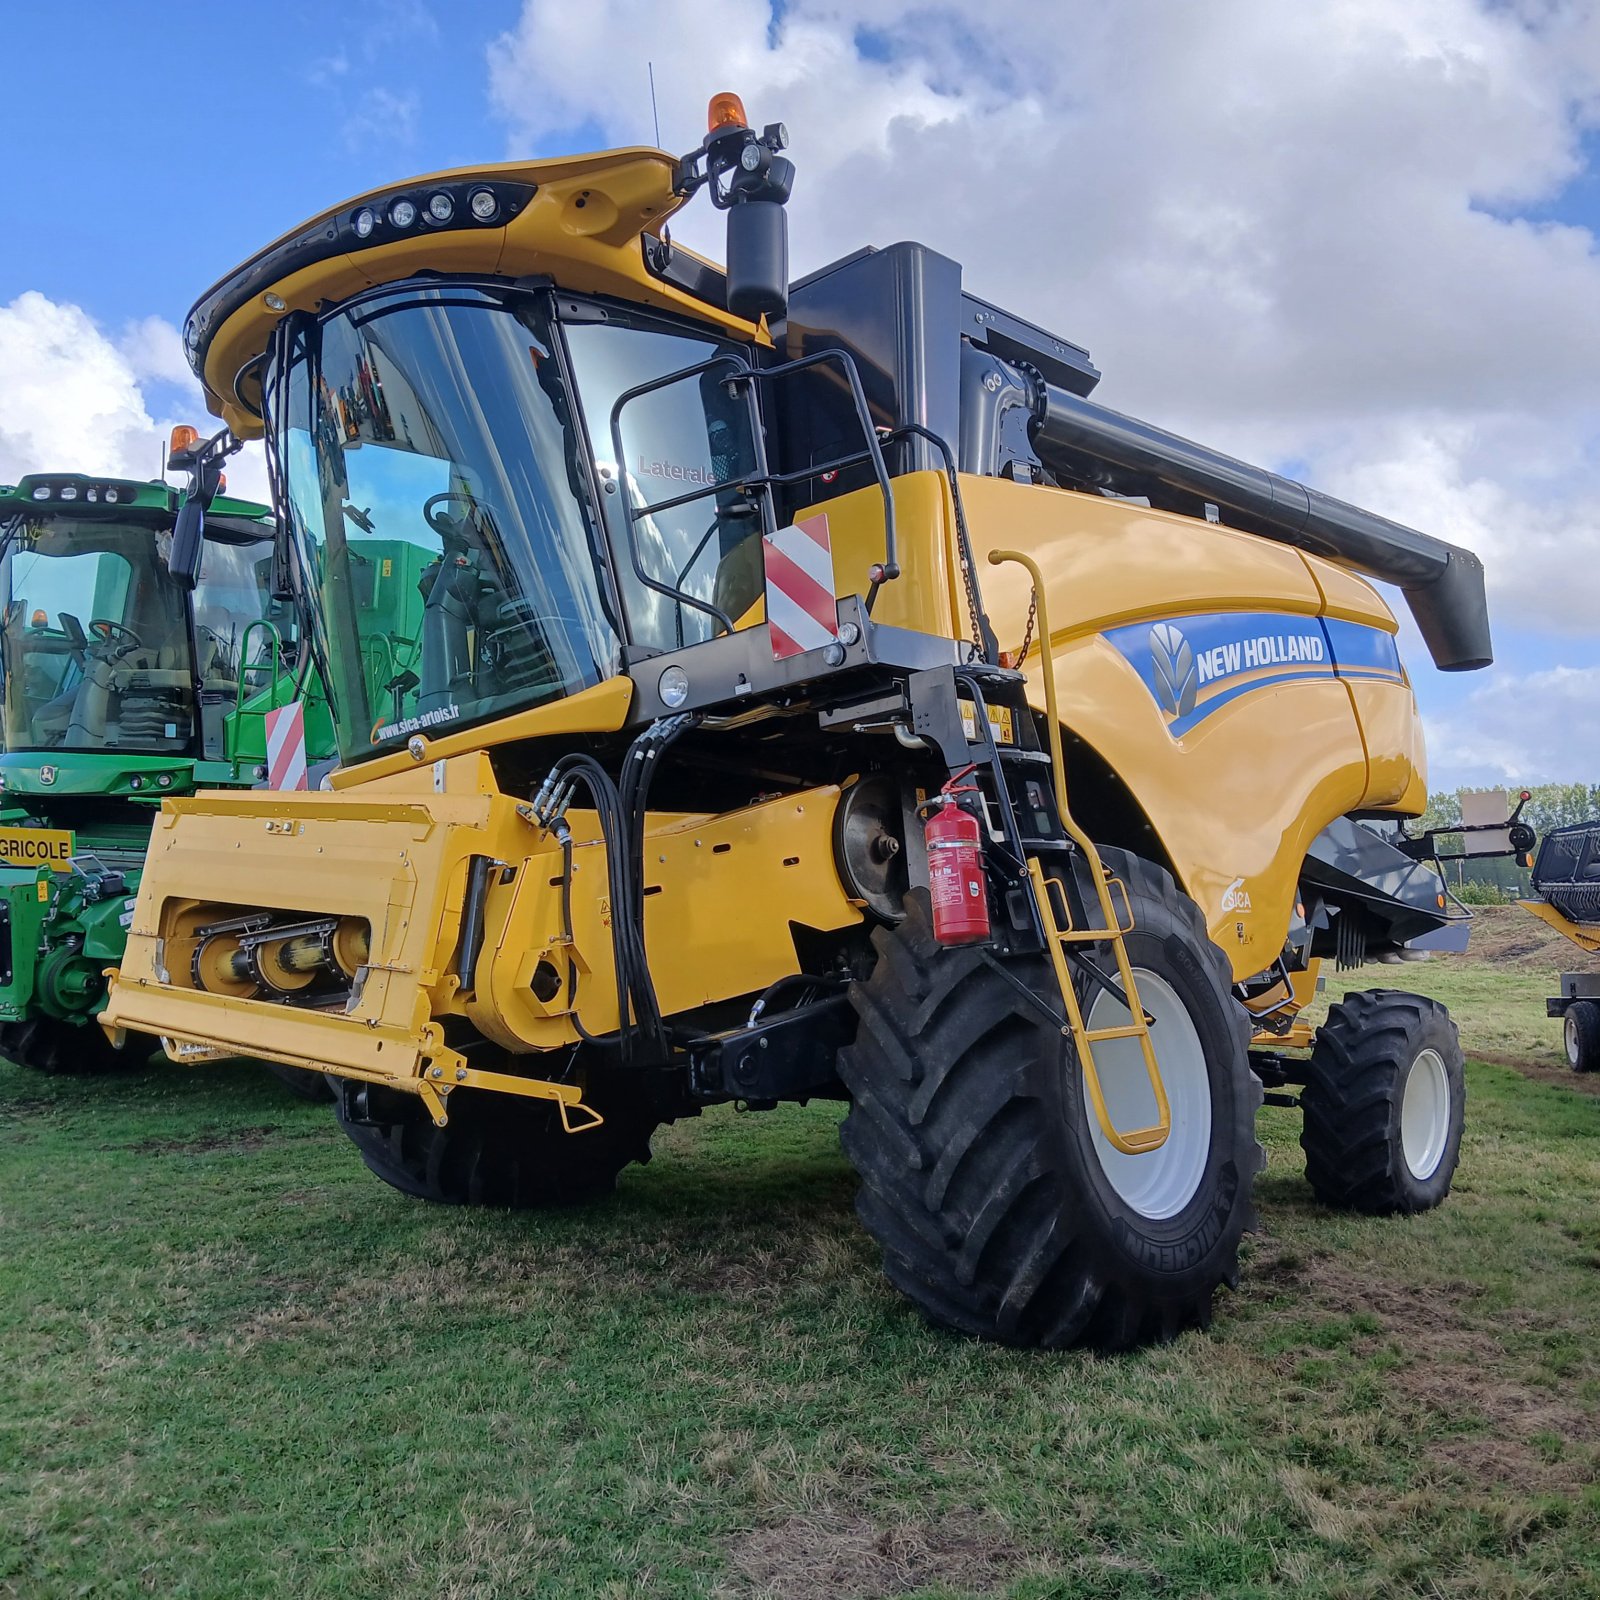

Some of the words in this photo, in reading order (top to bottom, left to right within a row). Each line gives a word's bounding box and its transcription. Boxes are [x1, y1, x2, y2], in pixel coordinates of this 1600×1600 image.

[638, 455, 717, 486] Laterale
[1196, 642, 1241, 683] NEW
[1243, 635, 1324, 668] HOLLAND
[378, 704, 460, 740] www.sica-artois.fr
[1228, 891, 1251, 908] SICA
[1124, 1210, 1223, 1272] MICHELIN
